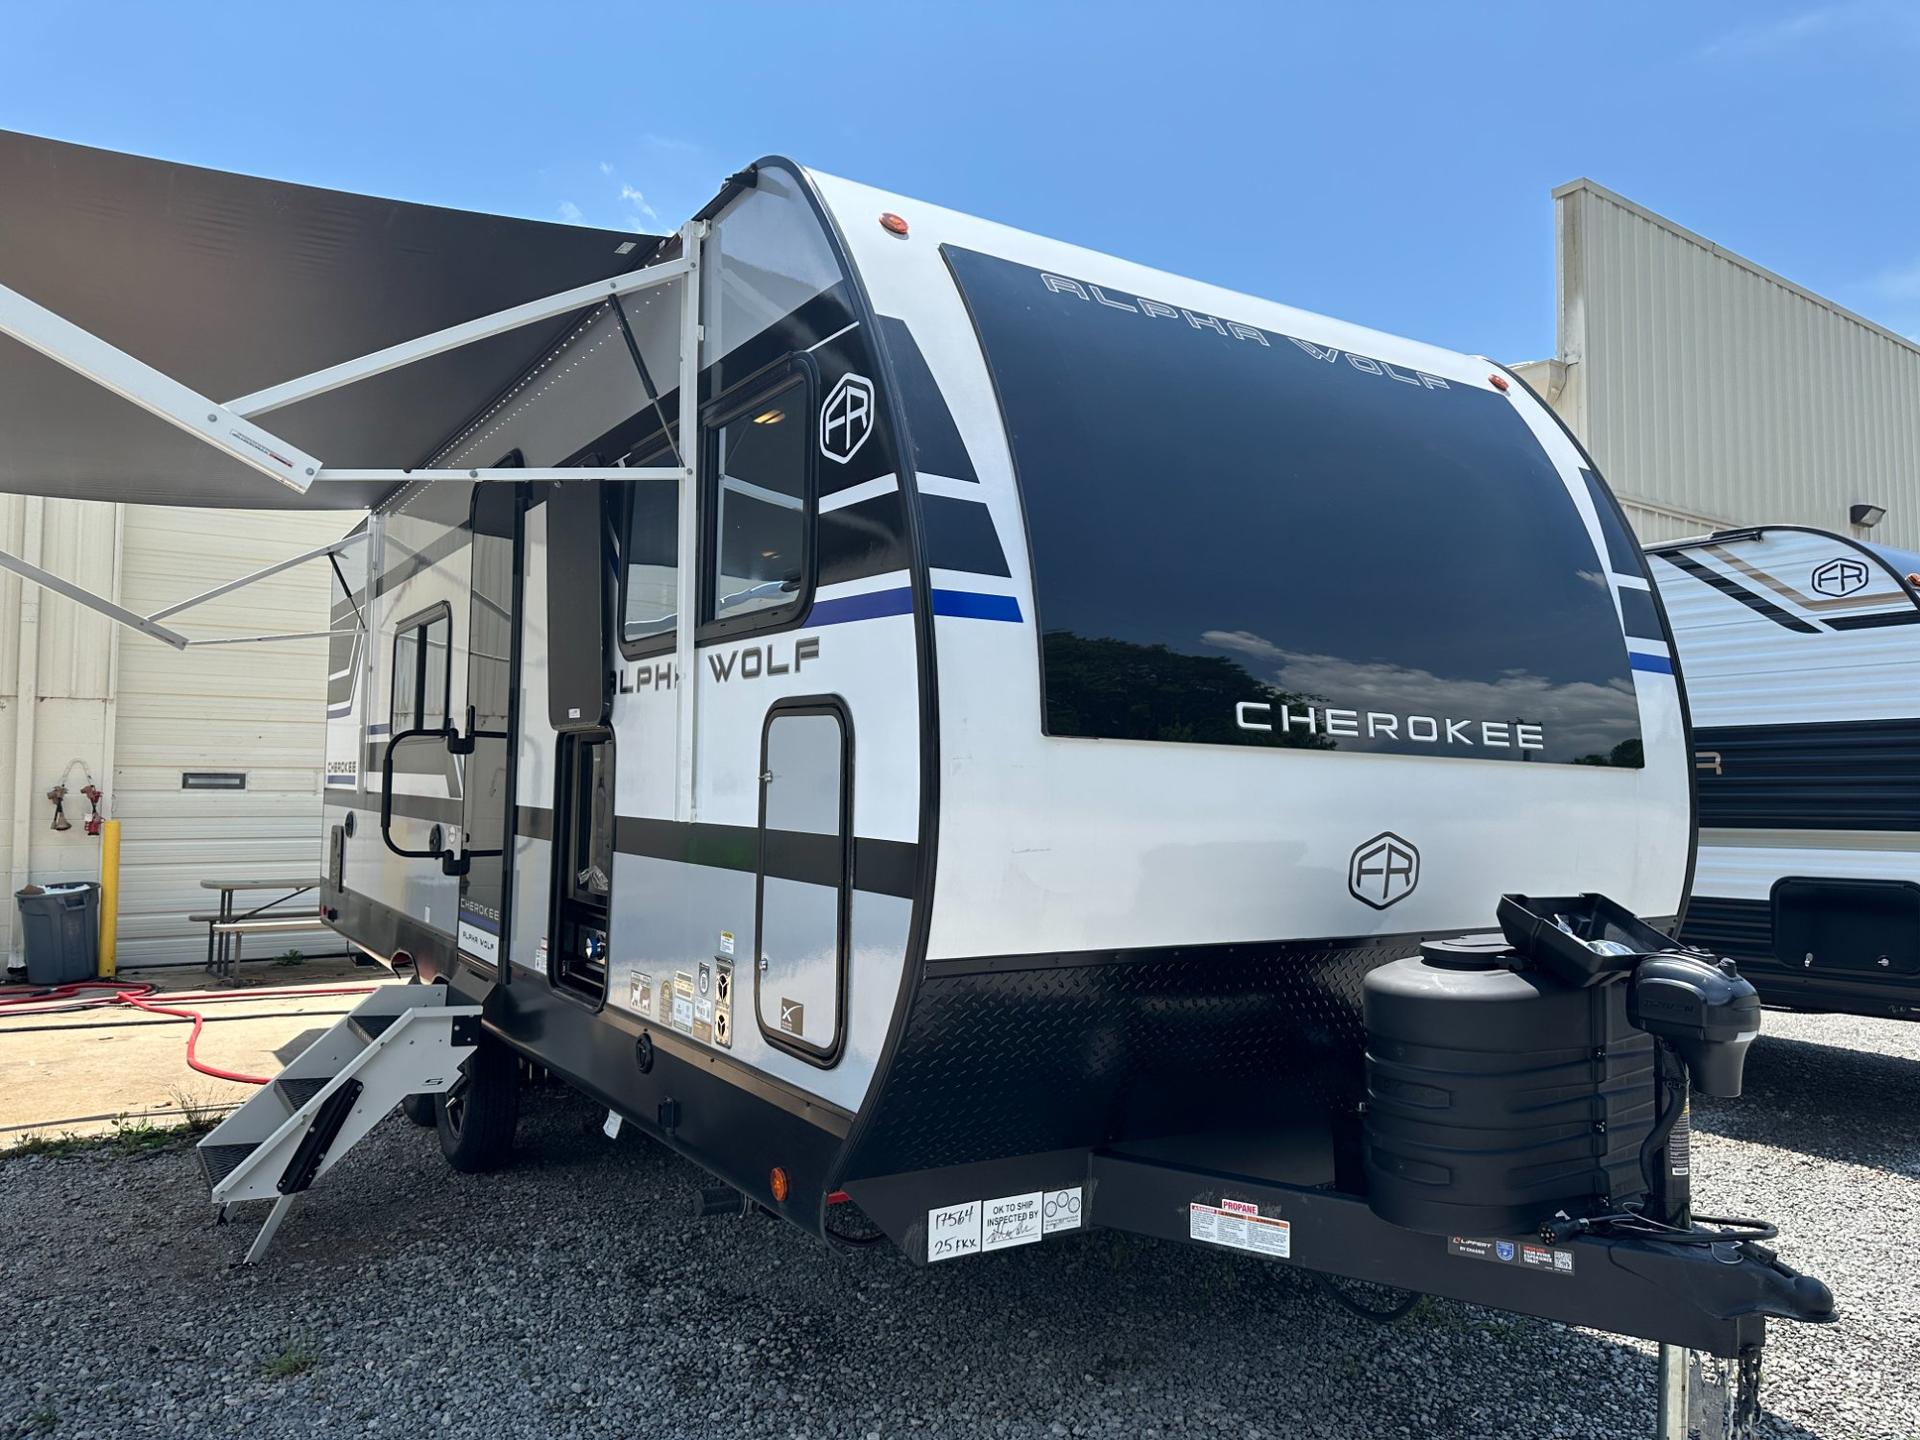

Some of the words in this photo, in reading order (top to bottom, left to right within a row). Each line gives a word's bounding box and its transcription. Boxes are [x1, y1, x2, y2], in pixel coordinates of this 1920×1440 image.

[1040, 272, 1271, 347] ALPHA
[1288, 336, 1451, 390] WOLF
[707, 636, 820, 683] WOLF
[1235, 701, 1544, 750] CHEROKEE
[460, 897, 500, 920] CHEROKEE
[987, 1212, 1028, 1227] INSPECTED
[1029, 1210, 1039, 1220] BY
[993, 1205, 1005, 1215] OK
[1006, 1203, 1016, 1213] TO
[1017, 1200, 1034, 1211] SHIP
[1223, 1200, 1257, 1214] PROPANE
